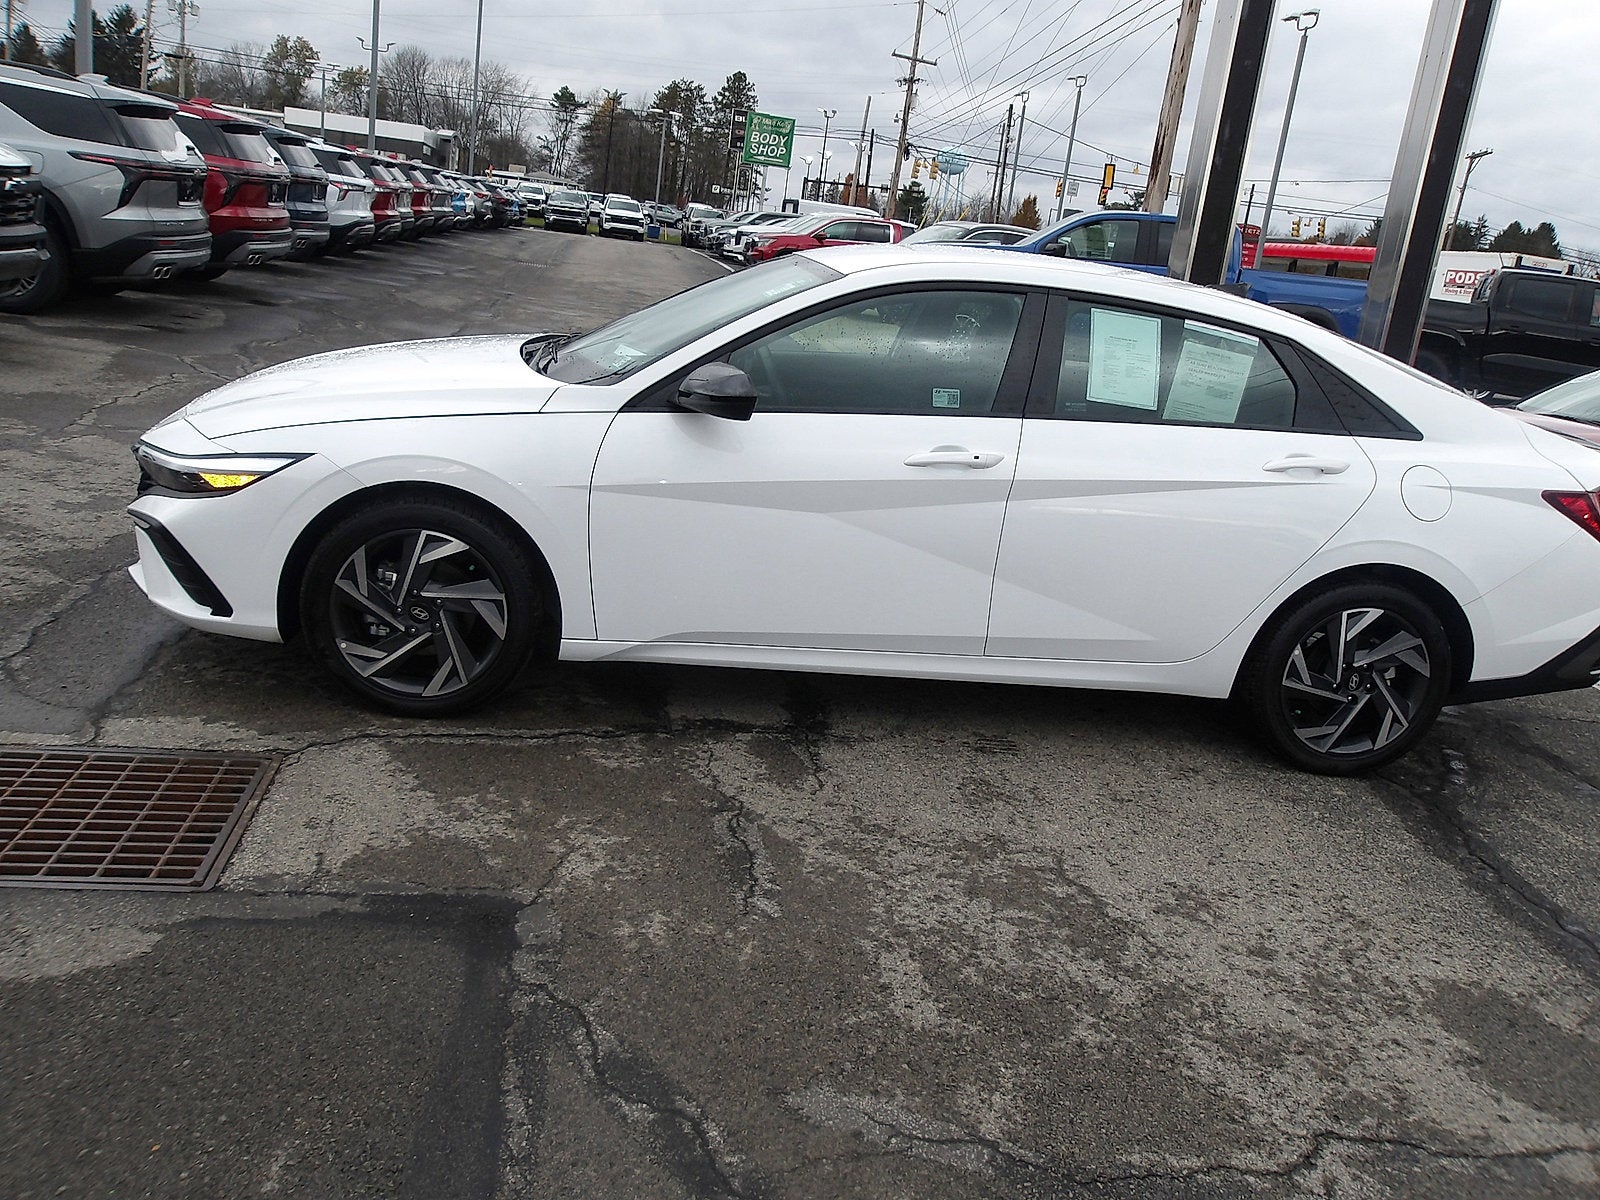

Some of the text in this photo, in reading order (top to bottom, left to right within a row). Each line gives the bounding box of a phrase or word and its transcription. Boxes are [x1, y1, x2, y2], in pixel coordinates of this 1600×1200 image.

[750, 131, 789, 147] BODY
[750, 142, 787, 157] SHOP
[1445, 271, 1484, 284] PODS
